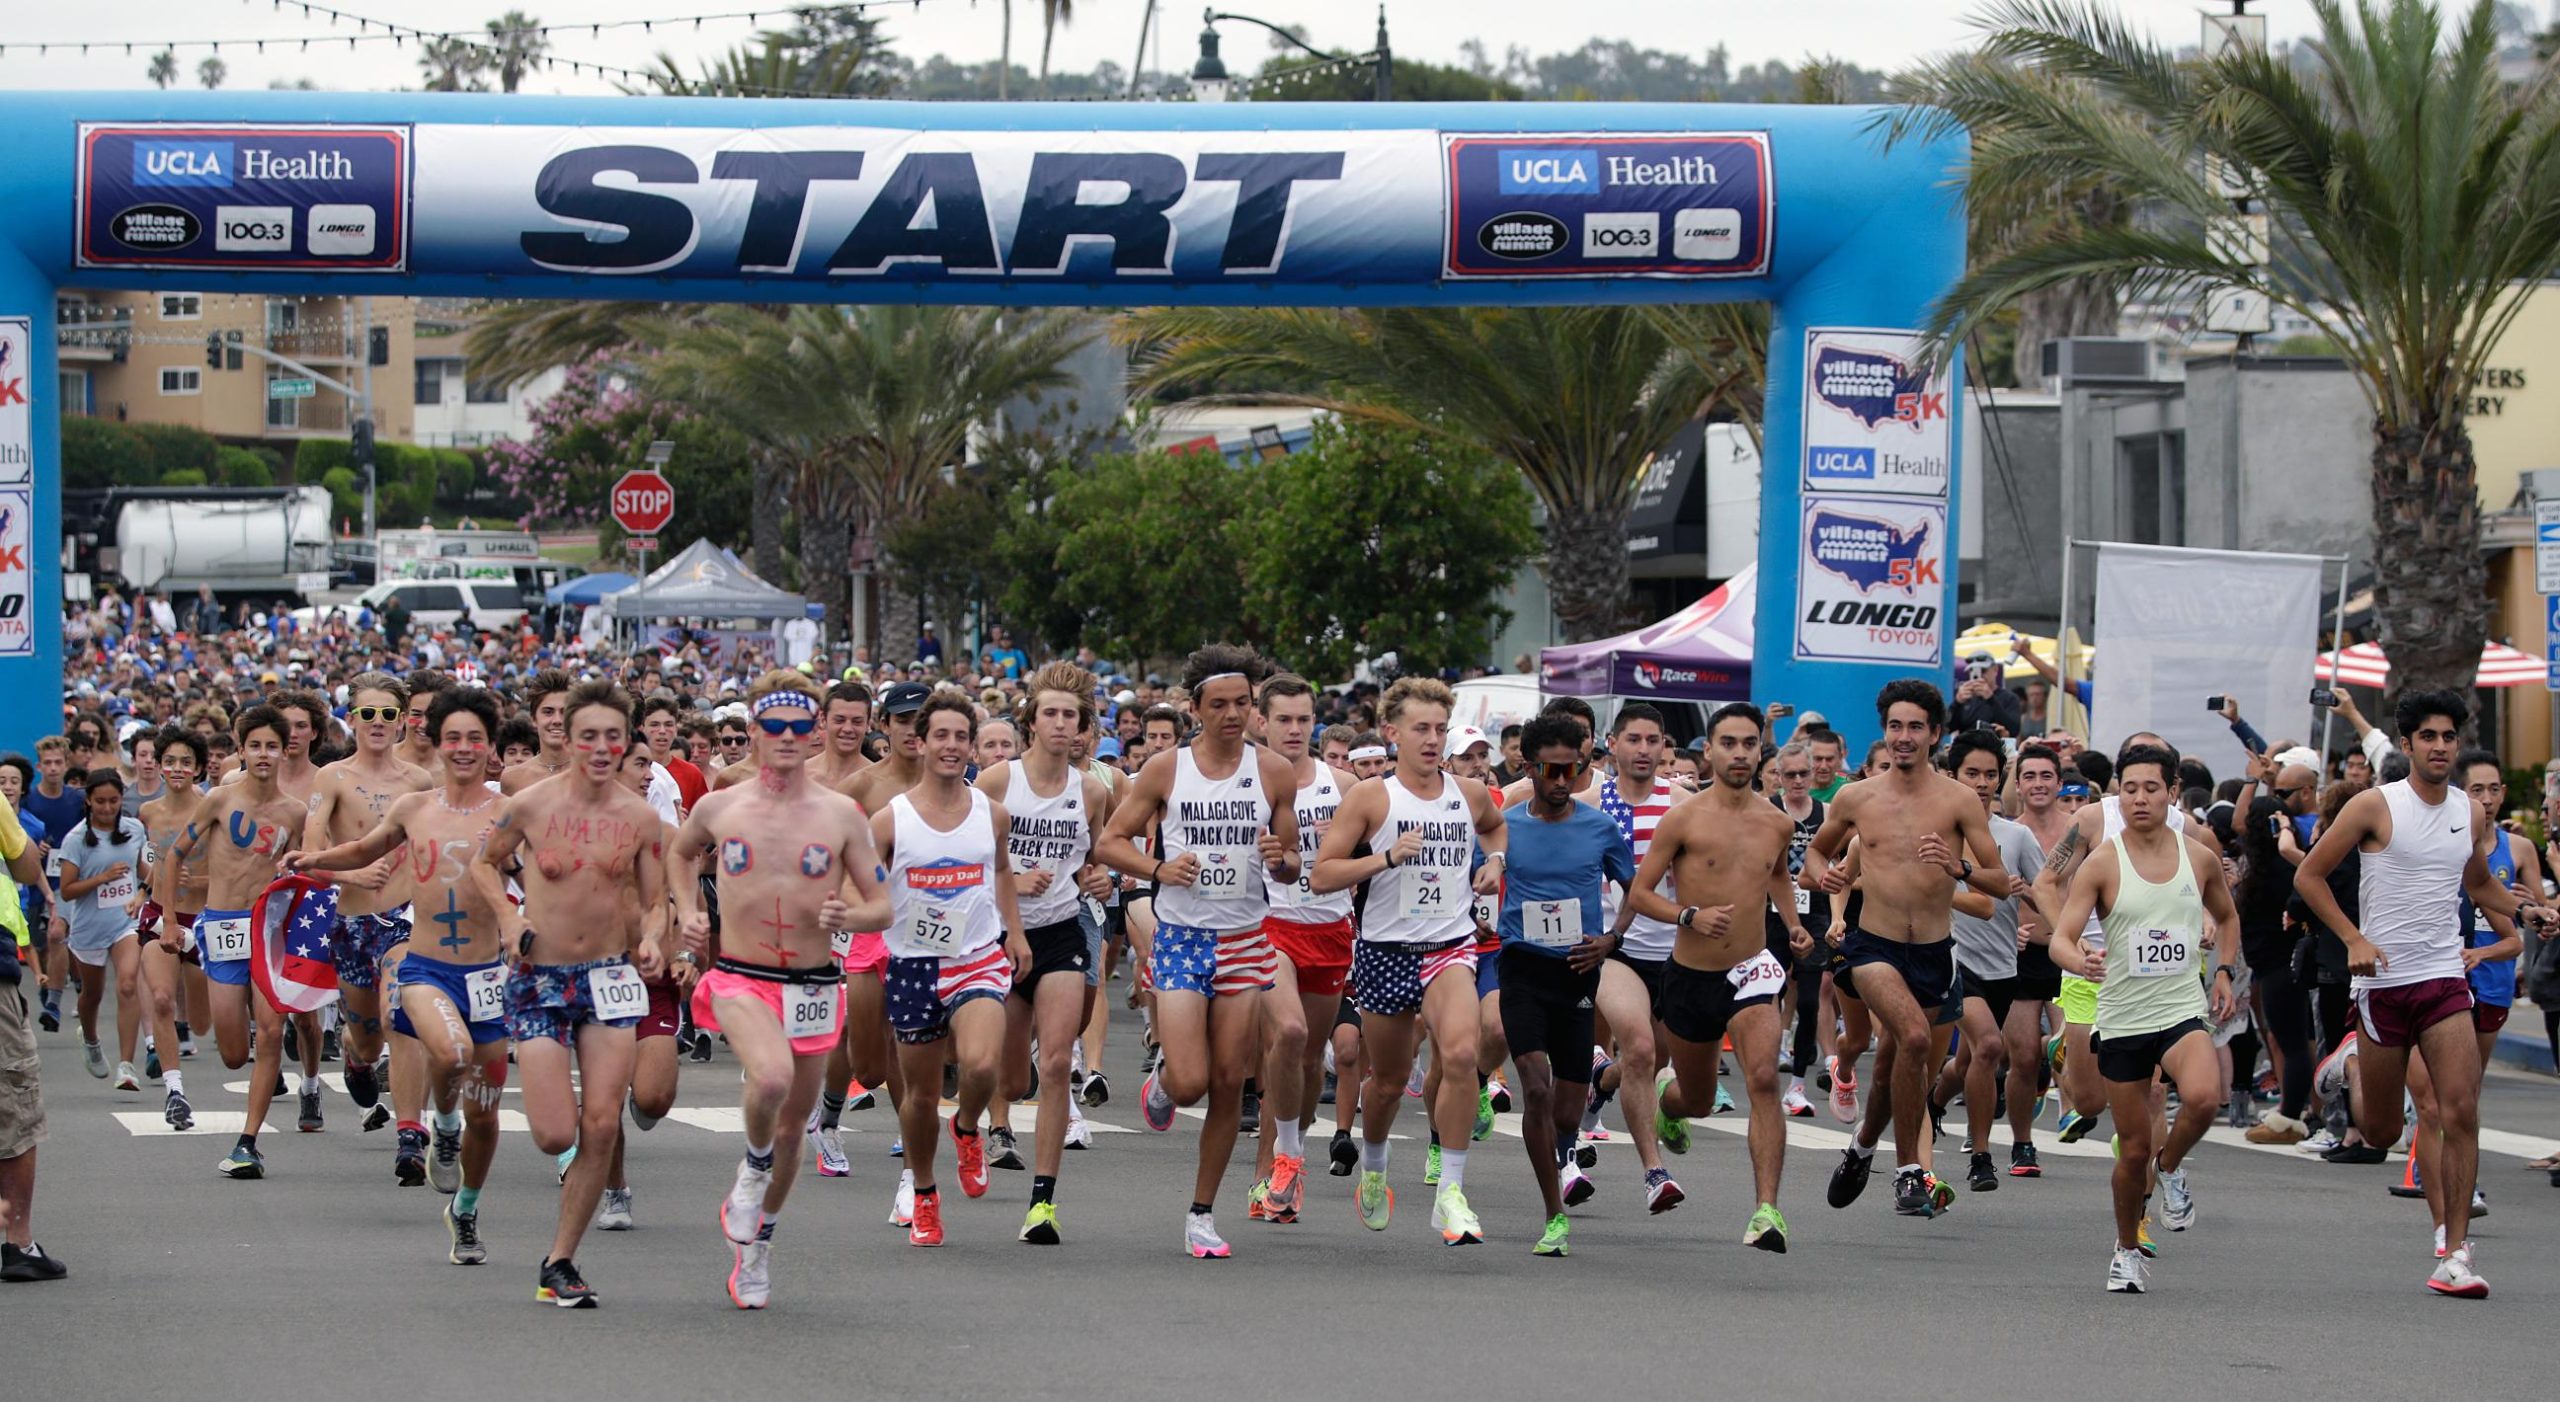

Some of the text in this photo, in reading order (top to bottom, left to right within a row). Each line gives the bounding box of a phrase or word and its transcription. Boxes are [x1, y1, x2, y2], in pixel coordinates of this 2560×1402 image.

[146, 149, 353, 180] UCLA Health
[1512, 155, 1717, 186] UCLA Health
[519, 144, 1346, 275] START
[125, 213, 185, 227] village
[318, 223, 365, 232] LONGO
[1493, 222, 1553, 236] village
[124, 230, 185, 242] runner
[224, 222, 284, 240] 100.3
[1591, 229, 1650, 246] 100.3
[1684, 227, 1730, 236] LONGO
[1492, 239, 1553, 250] runner
[1822, 360, 1894, 378] village
[1821, 382, 1894, 398] runner
[1894, 391, 1945, 422] 5K
[1815, 452, 1945, 478] UCLA Health
[616, 489, 669, 514] STOP
[1818, 524, 1888, 545] village
[1817, 547, 1888, 563] runner
[1888, 558, 1940, 587] 5K
[1806, 600, 1937, 630] LONGO
[1867, 627, 1935, 646] TOYOTA
[1661, 668, 1729, 684] RaceWire
[1181, 801, 1257, 822] MALAGA COVE
[1054, 820, 1079, 840] COVE
[1183, 826, 1256, 846] TRACK CLUB
[1444, 822, 1467, 842] COVE
[910, 869, 981, 885] Happy Dad
[1200, 868, 1237, 886] 602
[100, 883, 132, 899] 4963
[1418, 887, 1442, 904] 24
[916, 920, 952, 943] 572
[1541, 916, 1562, 934] 11
[216, 933, 245, 950] 167
[2136, 943, 2185, 963] 1209
[599, 983, 641, 1005] 1007
[795, 1000, 828, 1022] 806
